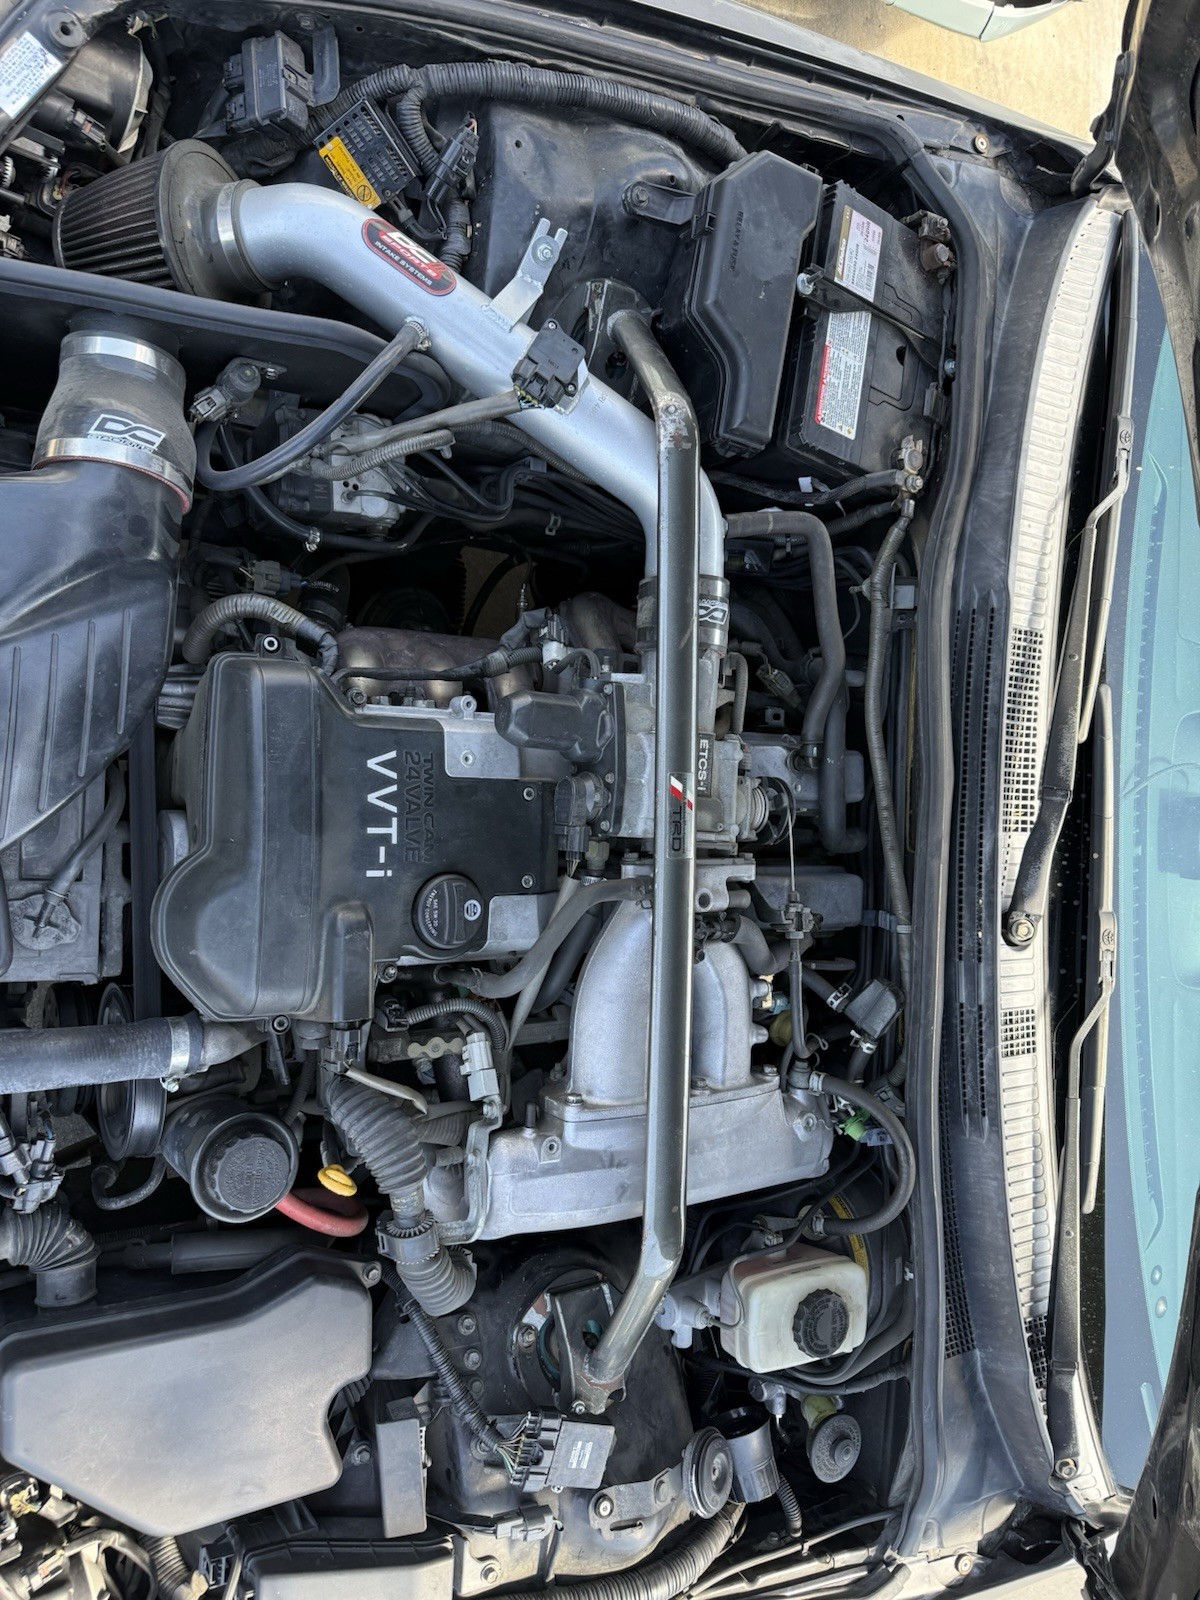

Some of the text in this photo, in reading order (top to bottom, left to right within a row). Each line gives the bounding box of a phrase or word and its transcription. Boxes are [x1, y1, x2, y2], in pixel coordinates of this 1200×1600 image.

[733, 210, 744, 239] RELAY
[374, 240, 433, 286] INTAKE SYSTEMS
[381, 234, 438, 277] SPORTS
[730, 247, 739, 272] FUSE
[87, 413, 167, 449] DC
[366, 749, 398, 878] VVT-i
[403, 750, 421, 863] 24VALVE
[421, 752, 435, 864] TWIN CAM
[671, 805, 682, 852] TRD
[426, 889, 439, 907] ENERGY
